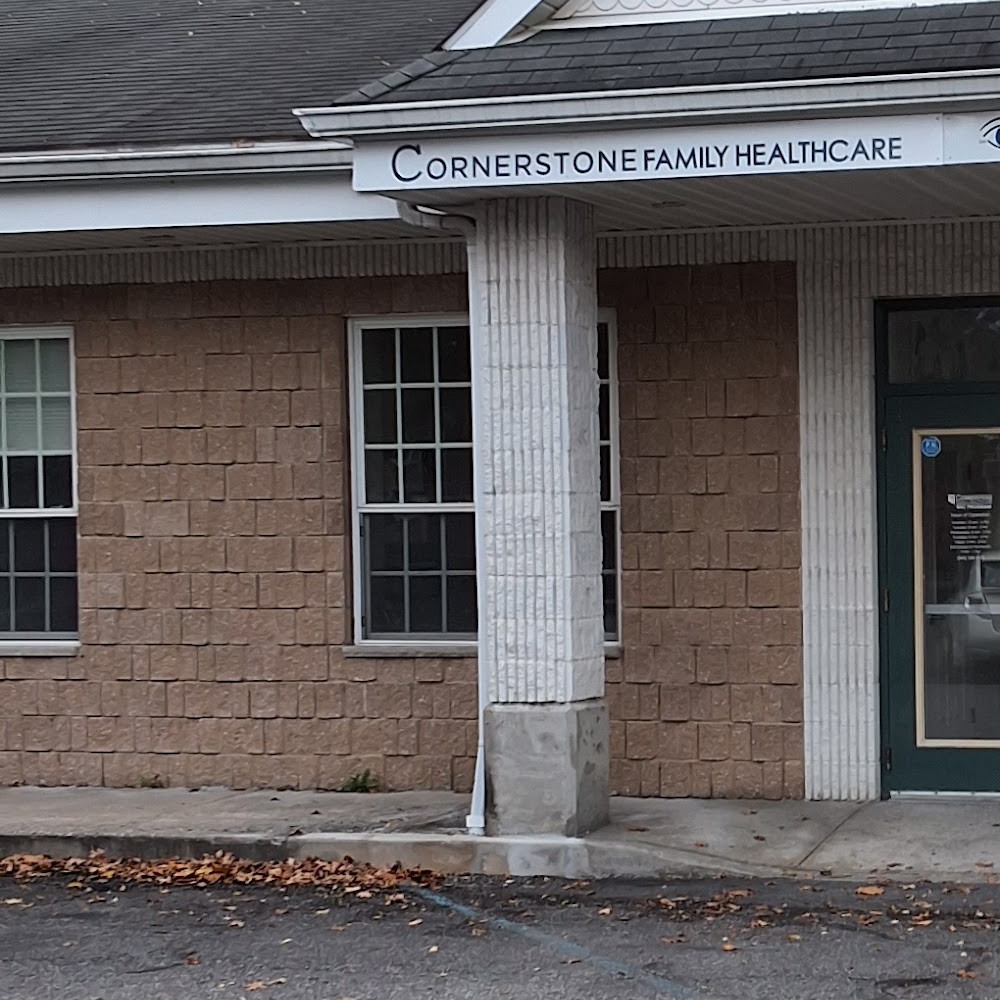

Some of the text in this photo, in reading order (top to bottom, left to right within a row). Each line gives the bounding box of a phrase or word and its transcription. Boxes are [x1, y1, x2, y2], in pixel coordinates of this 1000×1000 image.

[391, 137, 903, 182] CORNERSTONE FAMILY HEALTHCARE
